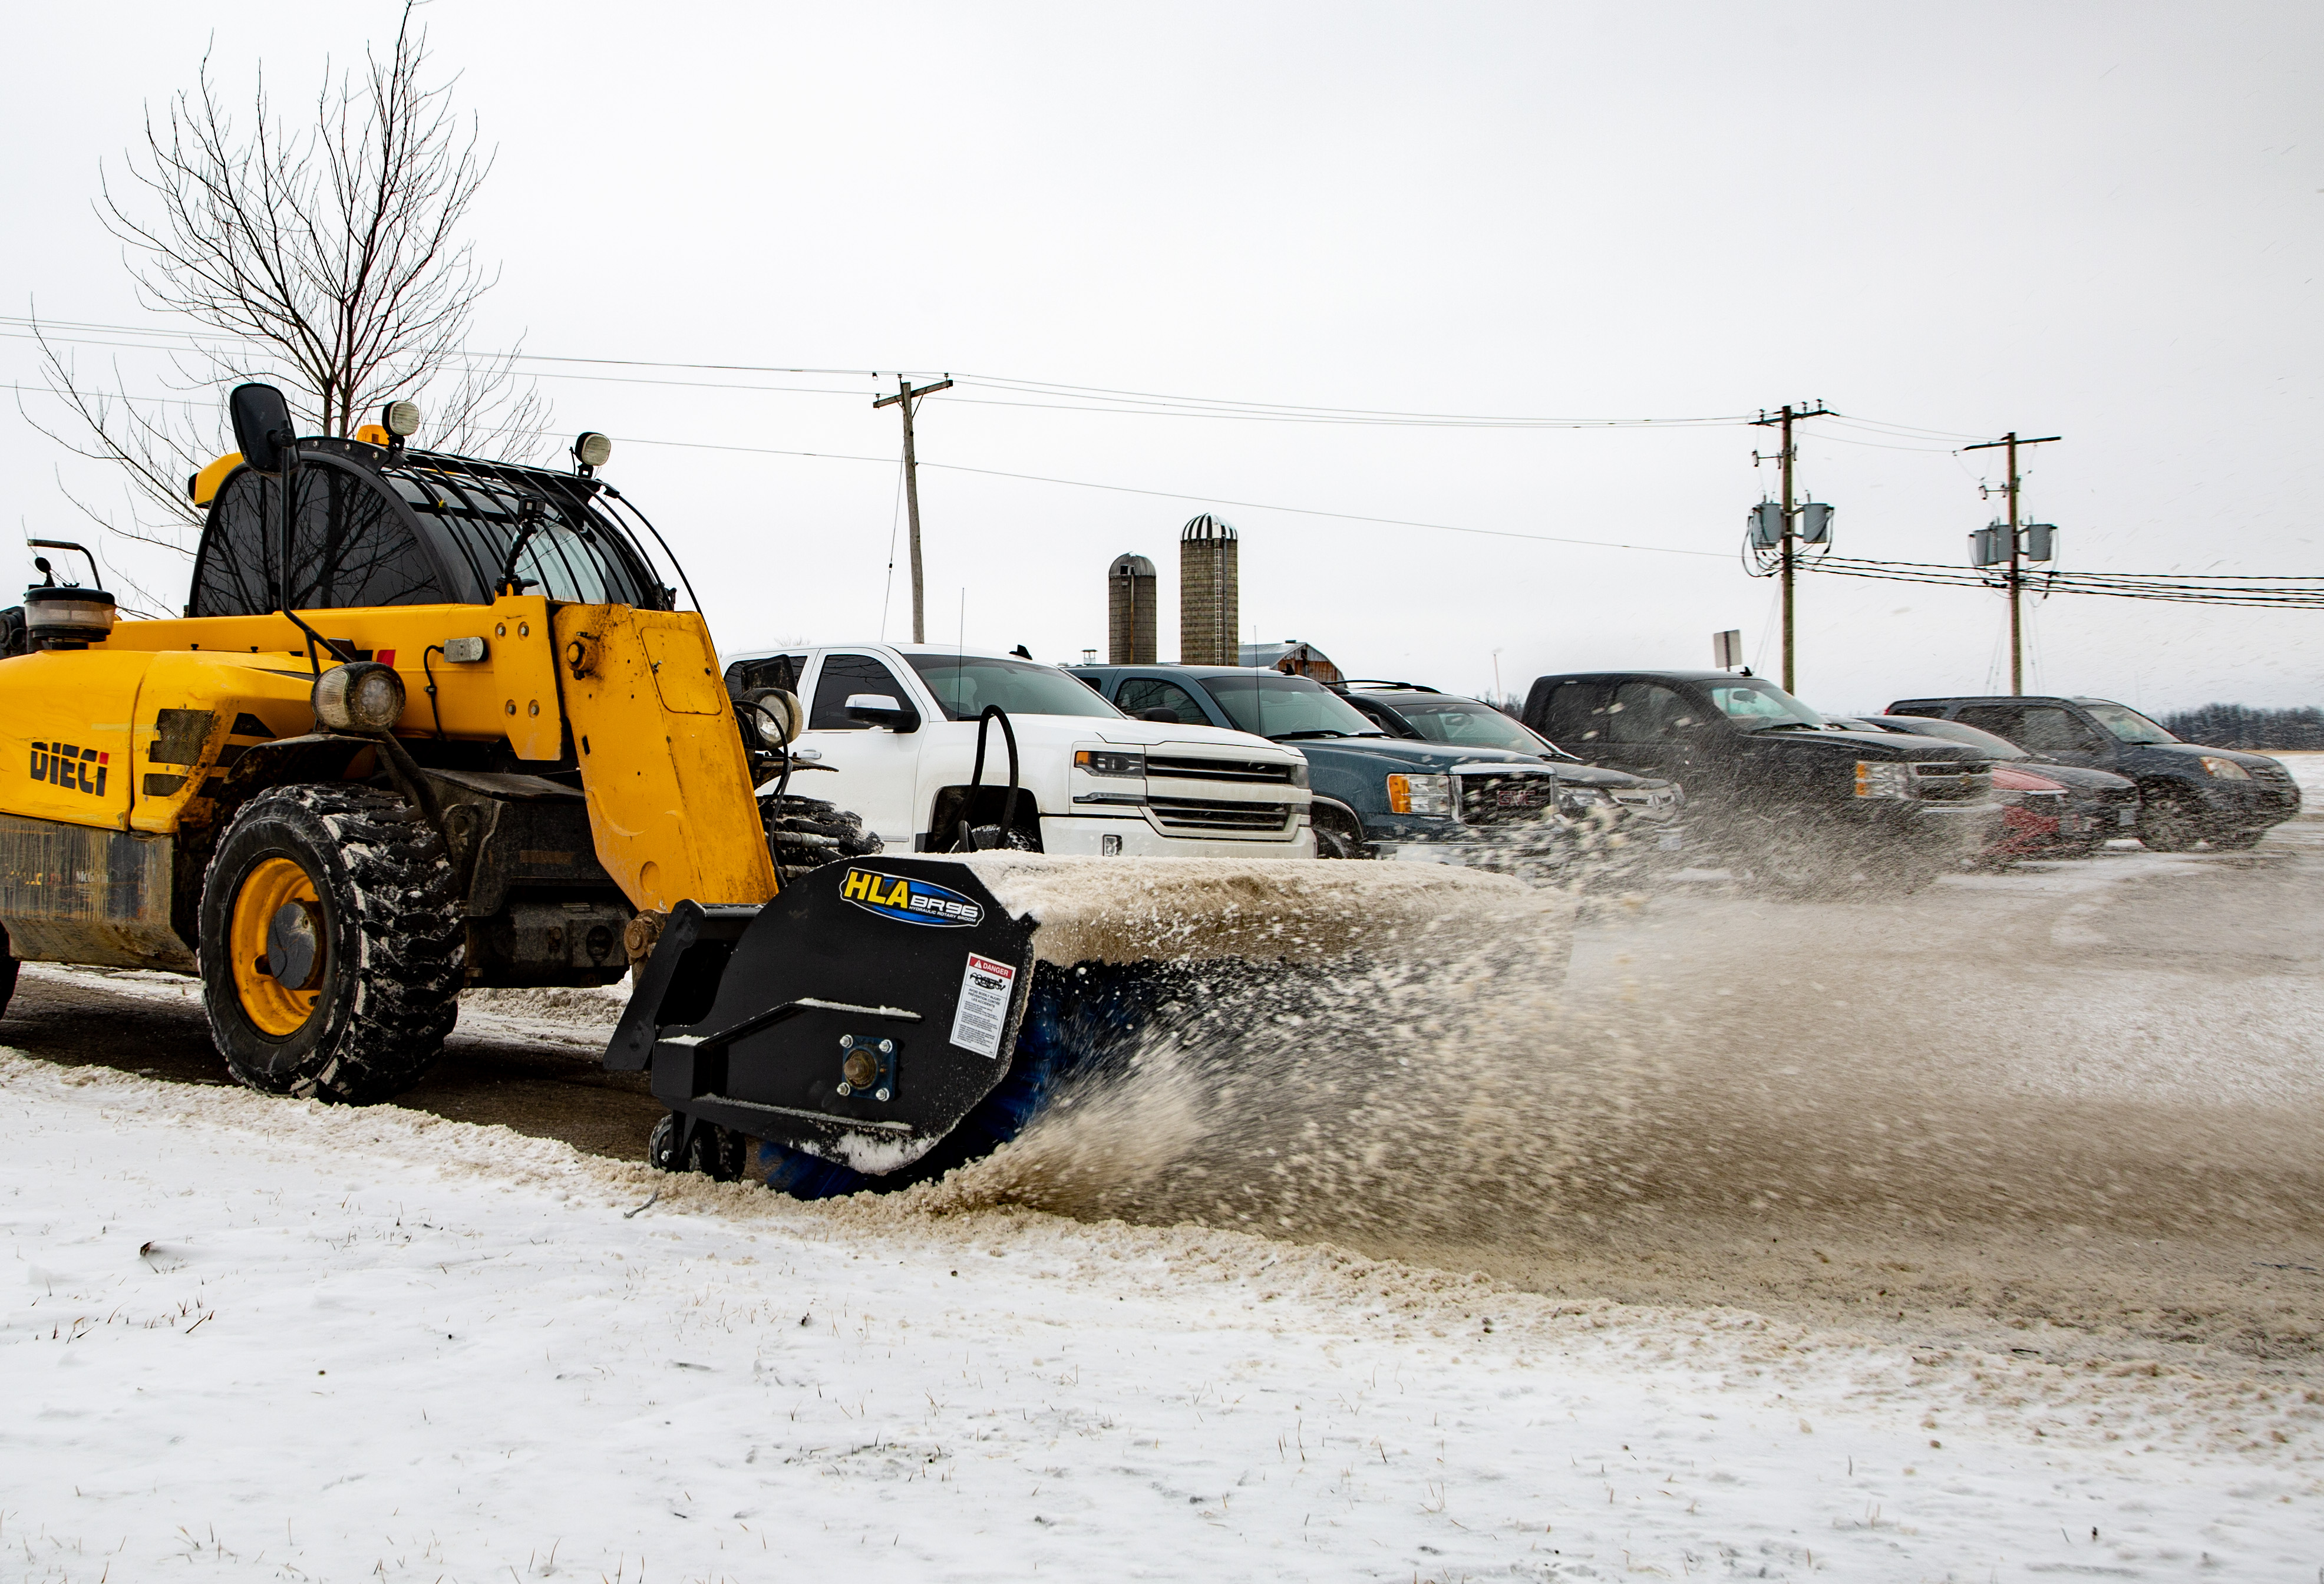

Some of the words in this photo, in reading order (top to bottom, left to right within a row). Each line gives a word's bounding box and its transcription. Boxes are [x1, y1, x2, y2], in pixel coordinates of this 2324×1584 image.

[844, 872, 907, 909] HLA
[909, 906, 936, 914] HYDRAULIC
[910, 895, 978, 918] BR96
[983, 963, 1009, 976] DANGER
